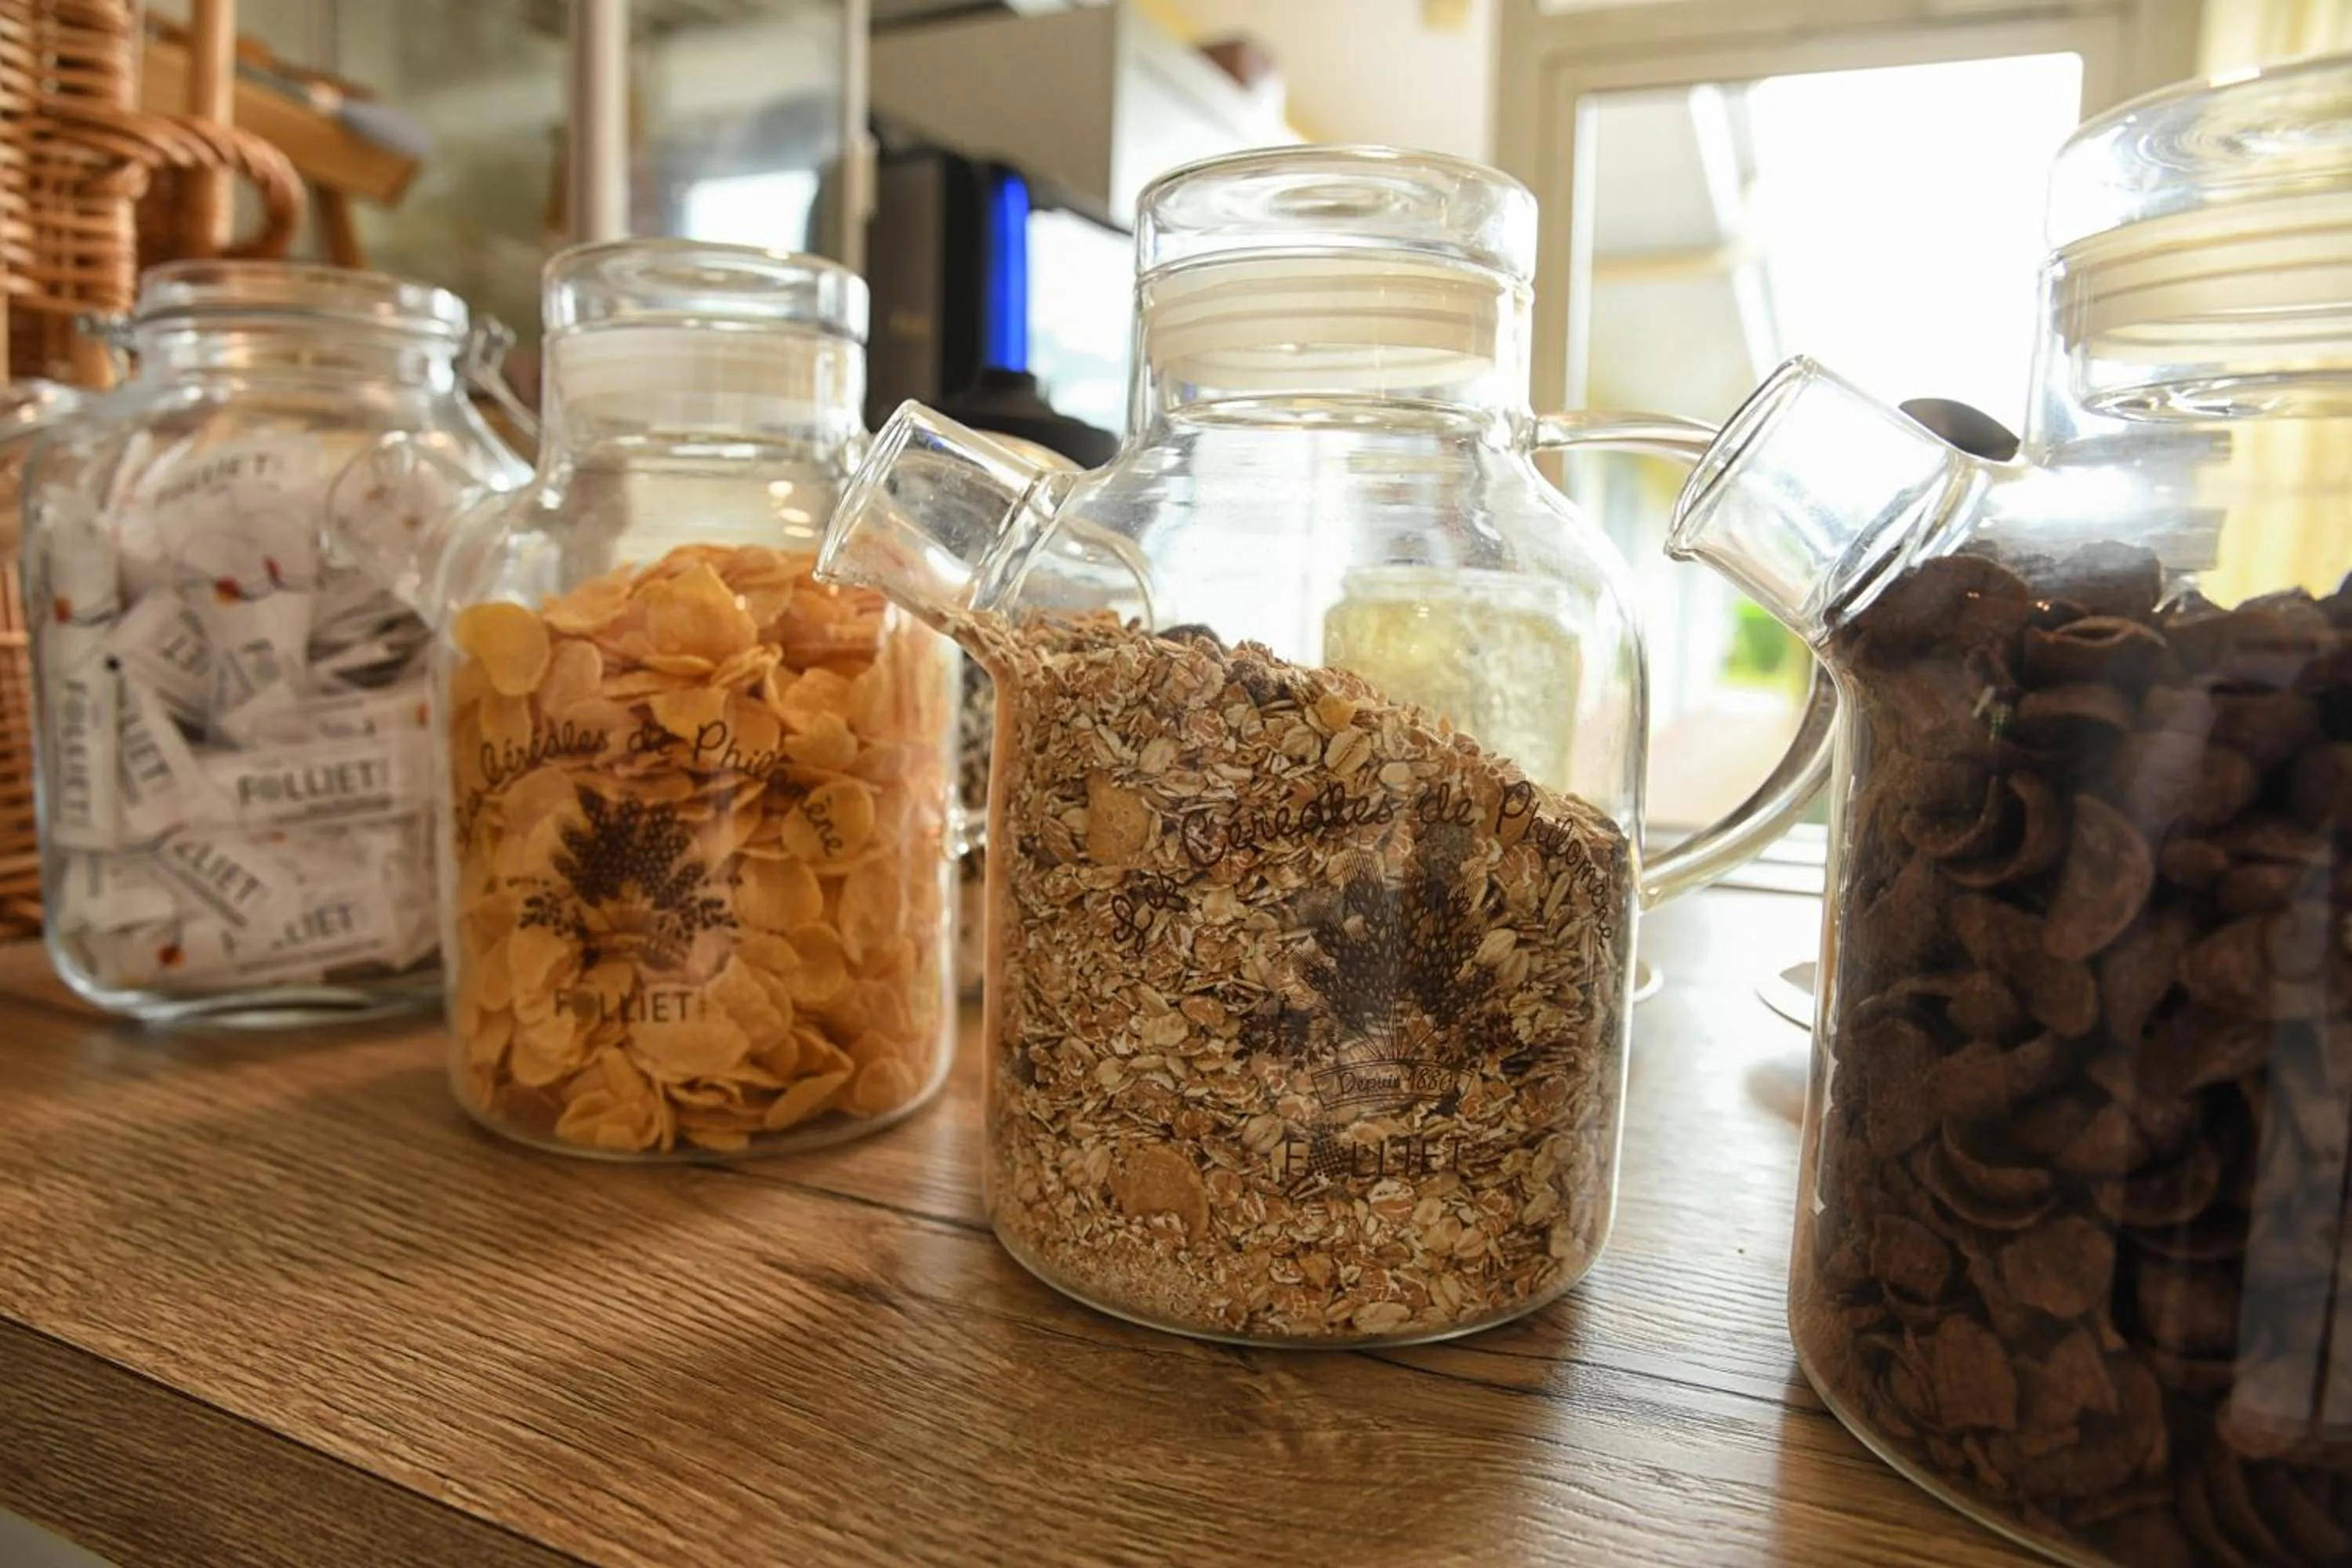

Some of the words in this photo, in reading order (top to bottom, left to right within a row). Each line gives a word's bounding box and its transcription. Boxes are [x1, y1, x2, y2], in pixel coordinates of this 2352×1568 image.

[627, 720, 674, 757] de
[1180, 779, 1396, 867] Céréales
[1415, 782, 1475, 826] de
[1494, 779, 1612, 947] Philomène
[1338, 1071, 1401, 1095] Depuis
[1406, 1066, 1454, 1093] 1880
